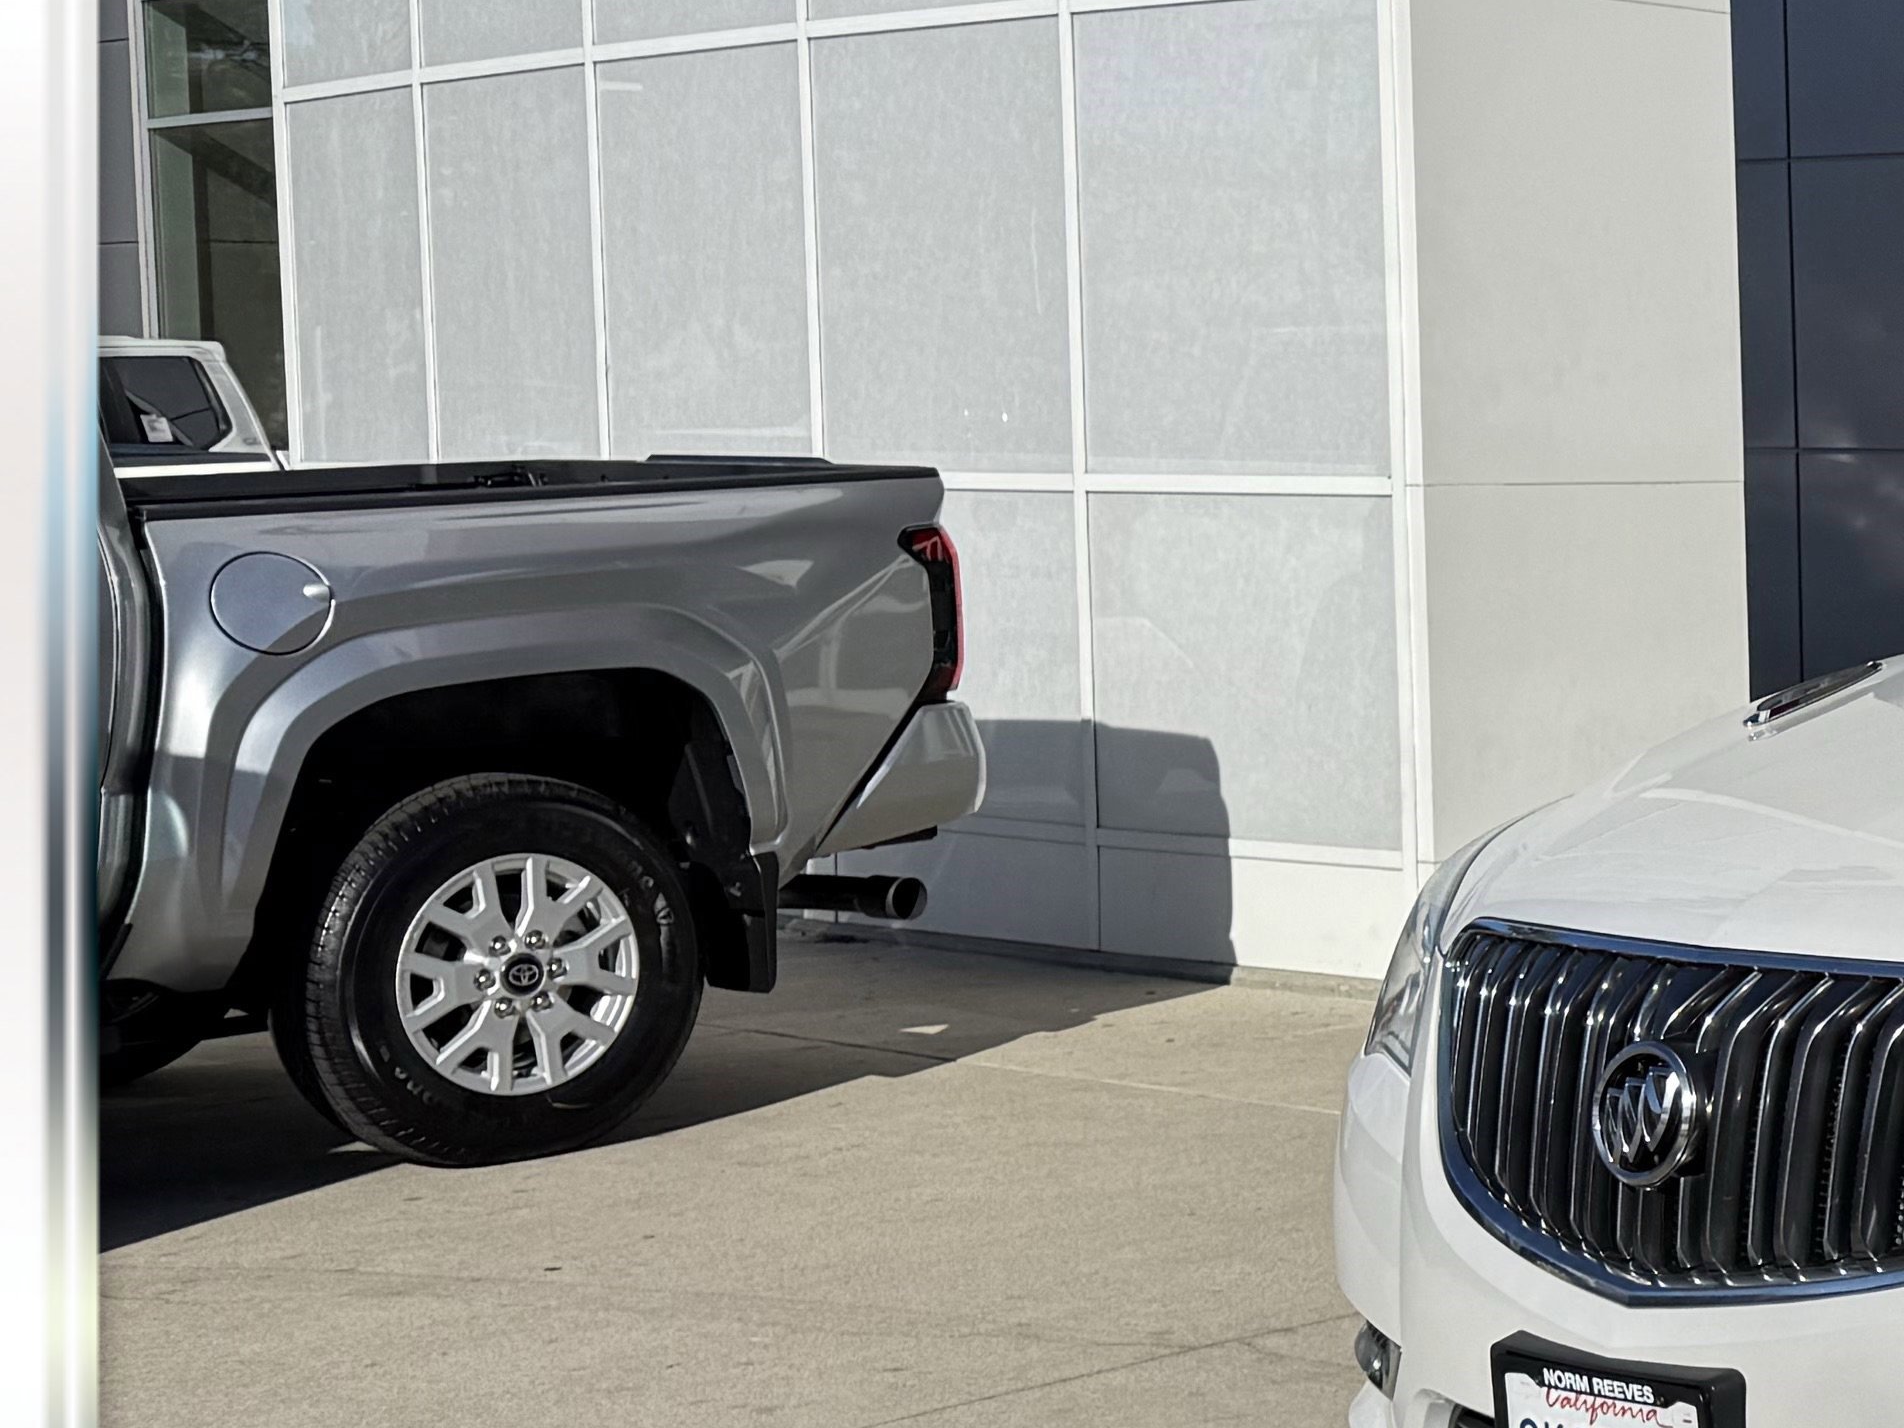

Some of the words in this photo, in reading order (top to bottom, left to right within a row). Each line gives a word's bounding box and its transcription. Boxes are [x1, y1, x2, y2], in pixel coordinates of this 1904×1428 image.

[1542, 1368, 1590, 1393] NORM
[1592, 1377, 1655, 1403] REEVES
[1545, 1386, 1674, 1428] California
